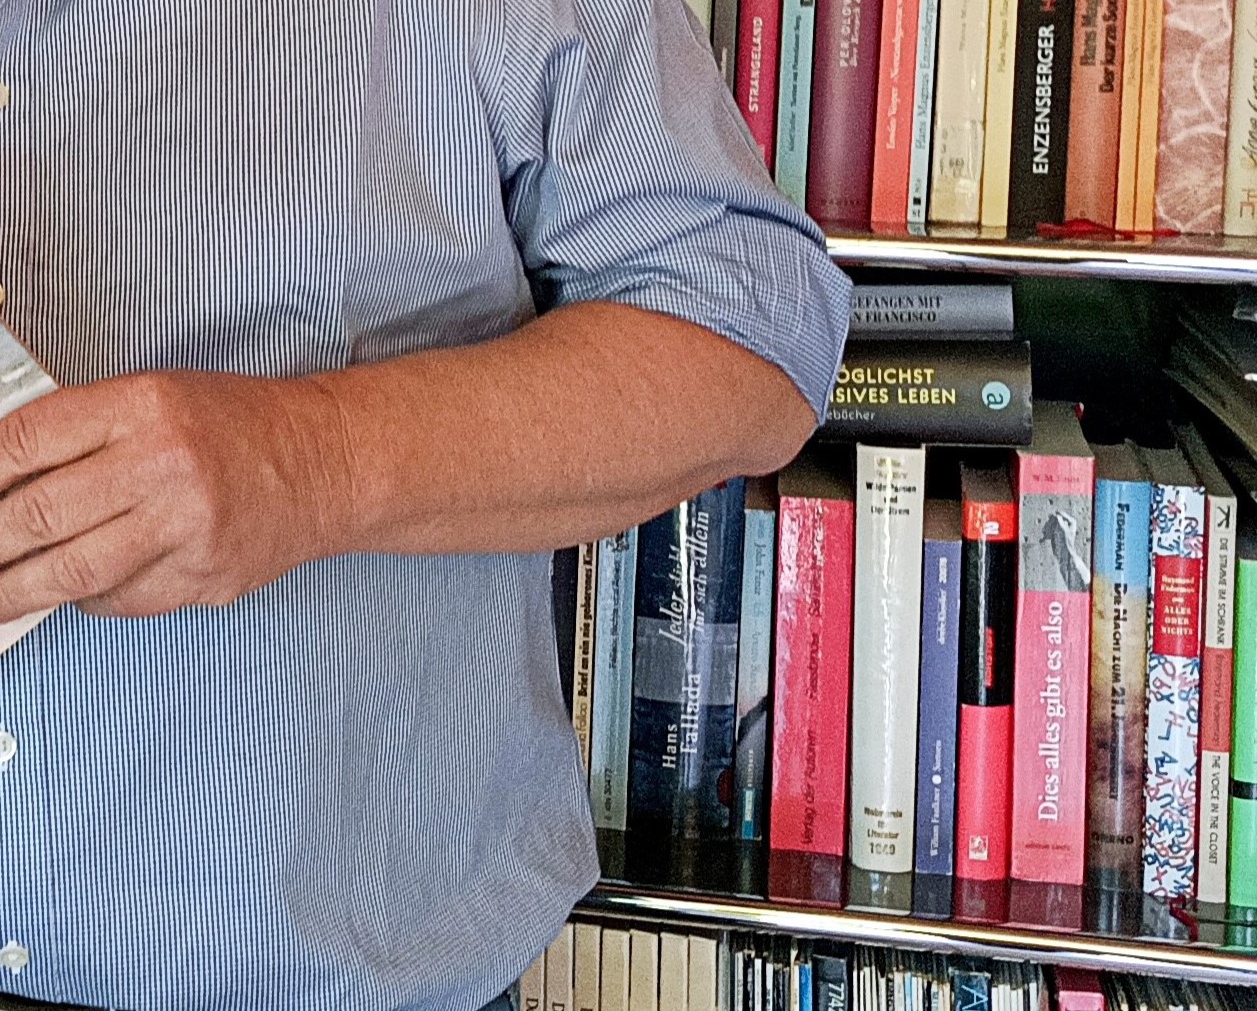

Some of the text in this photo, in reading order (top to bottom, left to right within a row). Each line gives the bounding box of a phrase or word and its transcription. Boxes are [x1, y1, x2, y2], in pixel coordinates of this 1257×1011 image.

[839, 40, 851, 68] PER
[1080, 30, 1098, 67] Hans
[1100, 24, 1118, 67] kurze
[748, 16, 764, 114] STRANGELAND
[1098, 67, 1116, 94] Der
[916, 72, 932, 117] Magnus
[1032, 24, 1055, 175] ENZENSBERGER
[914, 120, 927, 149] Hans
[866, 311, 937, 323] FRANCISCO
[897, 387, 957, 404] LEBEN
[685, 511, 709, 568] allein
[1114, 502, 1131, 571] FEDERMAN
[582, 569, 595, 621] geborenes
[690, 573, 707, 604] sich
[582, 622, 593, 639] nie
[657, 591, 685, 646] Jeder
[1040, 599, 1064, 645] also
[1163, 616, 1190, 626] ODER
[581, 640, 592, 656] ein
[1046, 649, 1063, 672] es
[578, 671, 590, 698] Brief
[1039, 675, 1067, 719] gibt
[1110, 685, 1126, 713] 21.
[661, 673, 701, 769] Hans Fallada
[1038, 721, 1062, 770] alles
[1210, 754, 1221, 769] THE
[1036, 774, 1060, 822] Dies
[1210, 772, 1221, 801] VOICE
[1209, 814, 1221, 829] THE
[929, 824, 940, 857] William
[1208, 831, 1220, 865] CLOSET
